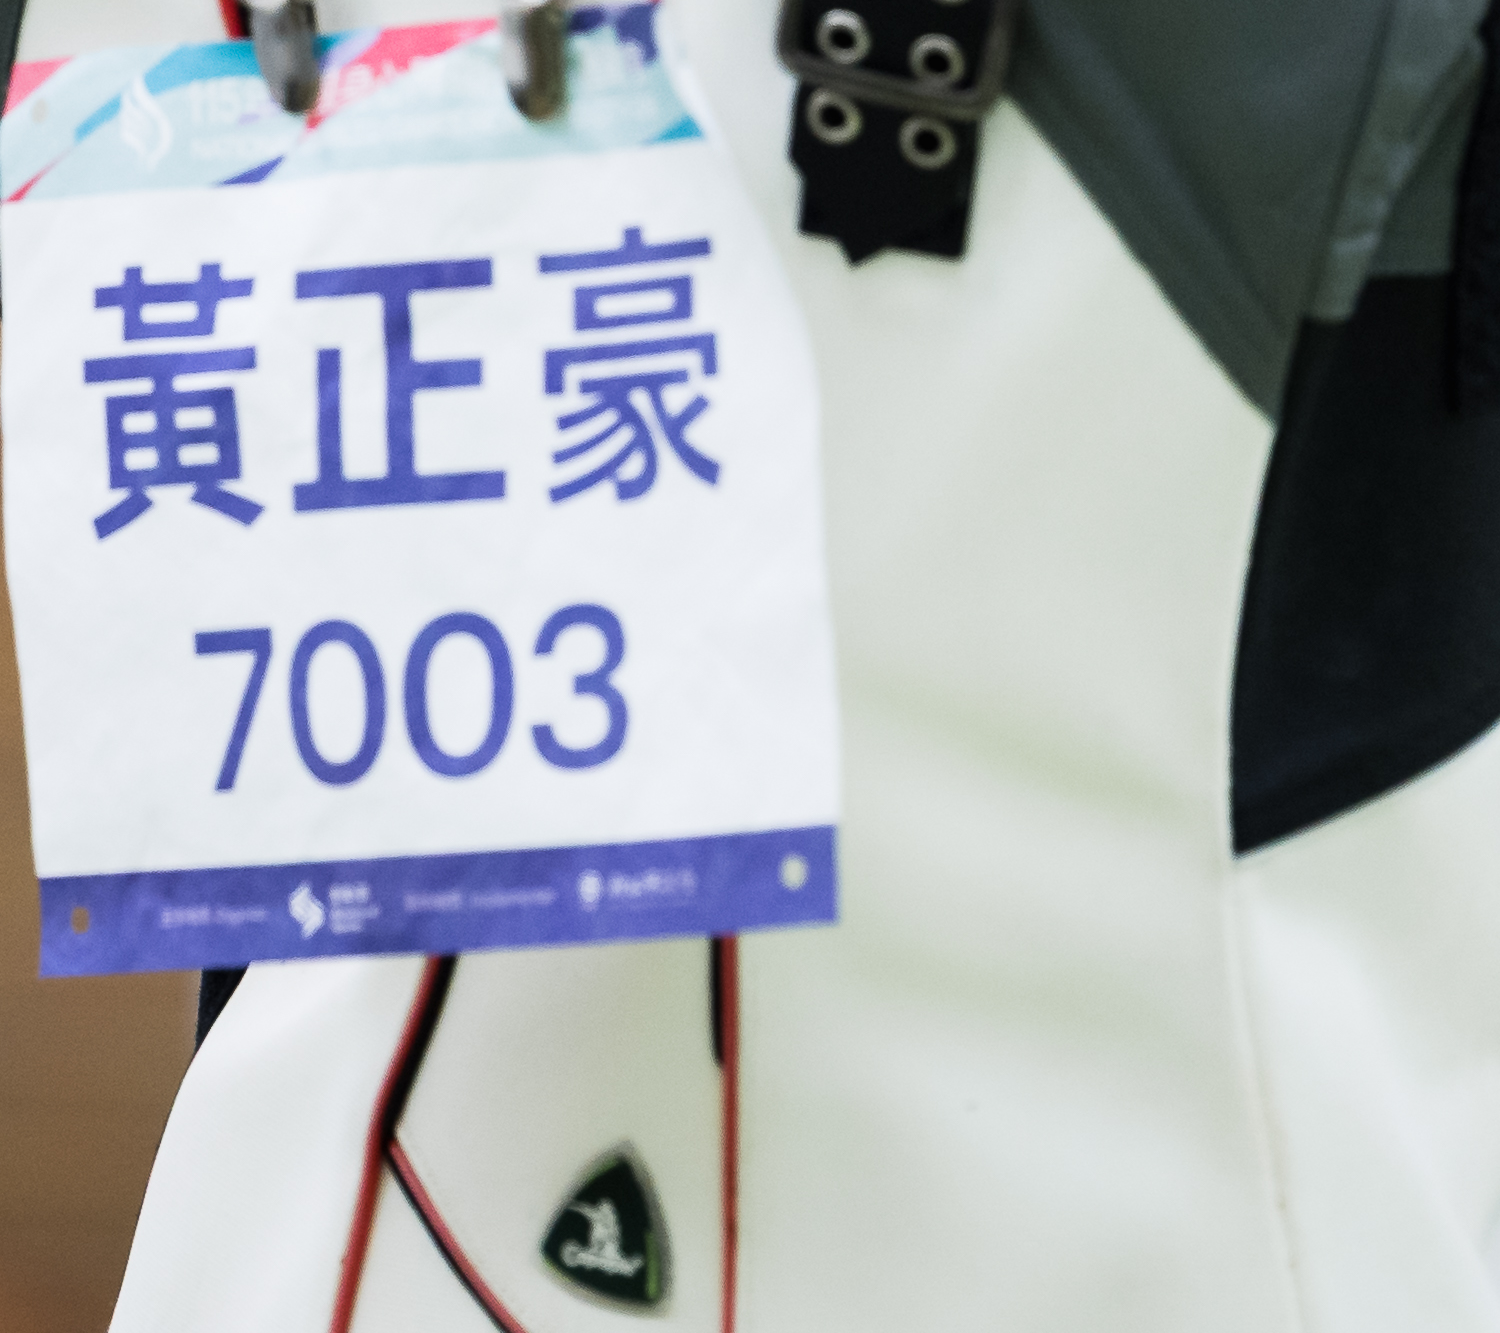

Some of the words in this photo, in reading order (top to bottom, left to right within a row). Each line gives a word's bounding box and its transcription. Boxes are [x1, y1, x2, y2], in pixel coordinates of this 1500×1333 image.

[84, 227, 720, 539] 黃正豪
[194, 604, 628, 792] 7003
